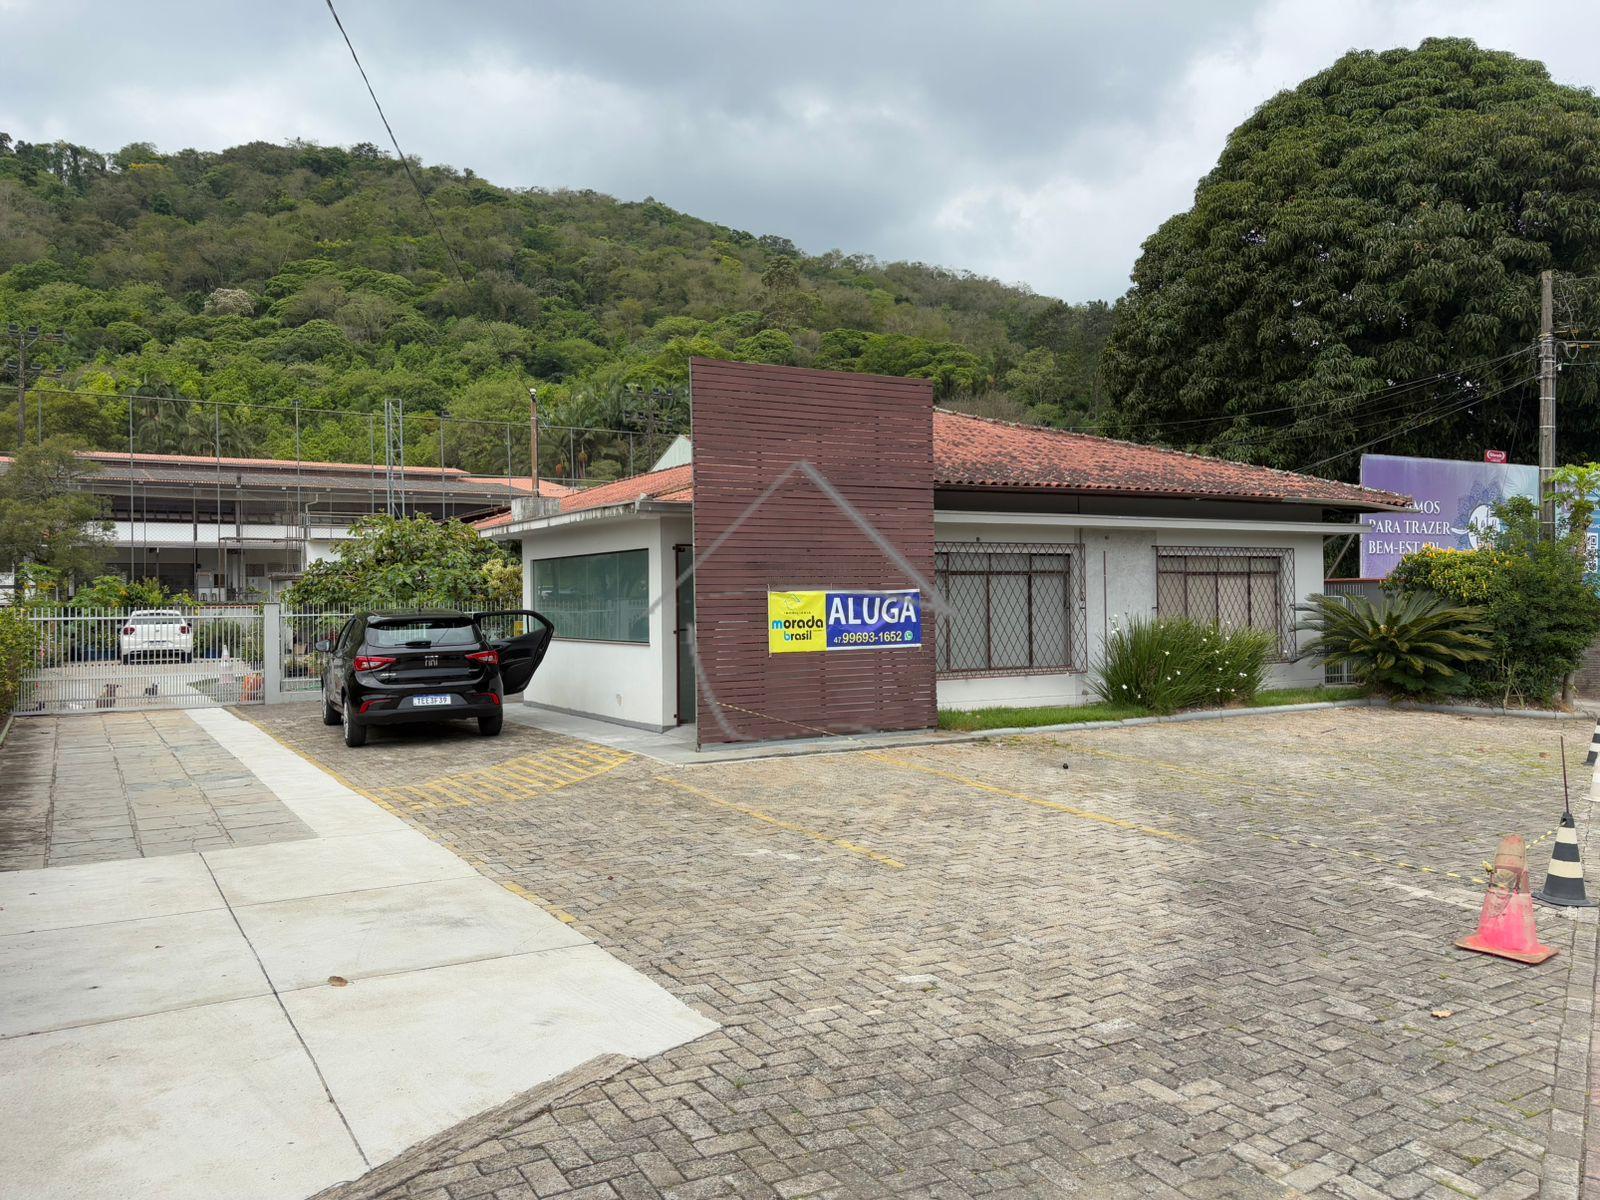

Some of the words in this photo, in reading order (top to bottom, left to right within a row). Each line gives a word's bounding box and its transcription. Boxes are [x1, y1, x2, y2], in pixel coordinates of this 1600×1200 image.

[1369, 519, 1401, 533] PARA
[1404, 520, 1450, 535] TRAZER
[828, 596, 917, 625] ALUGA
[772, 615, 824, 629] morada
[783, 630, 812, 641] brasil
